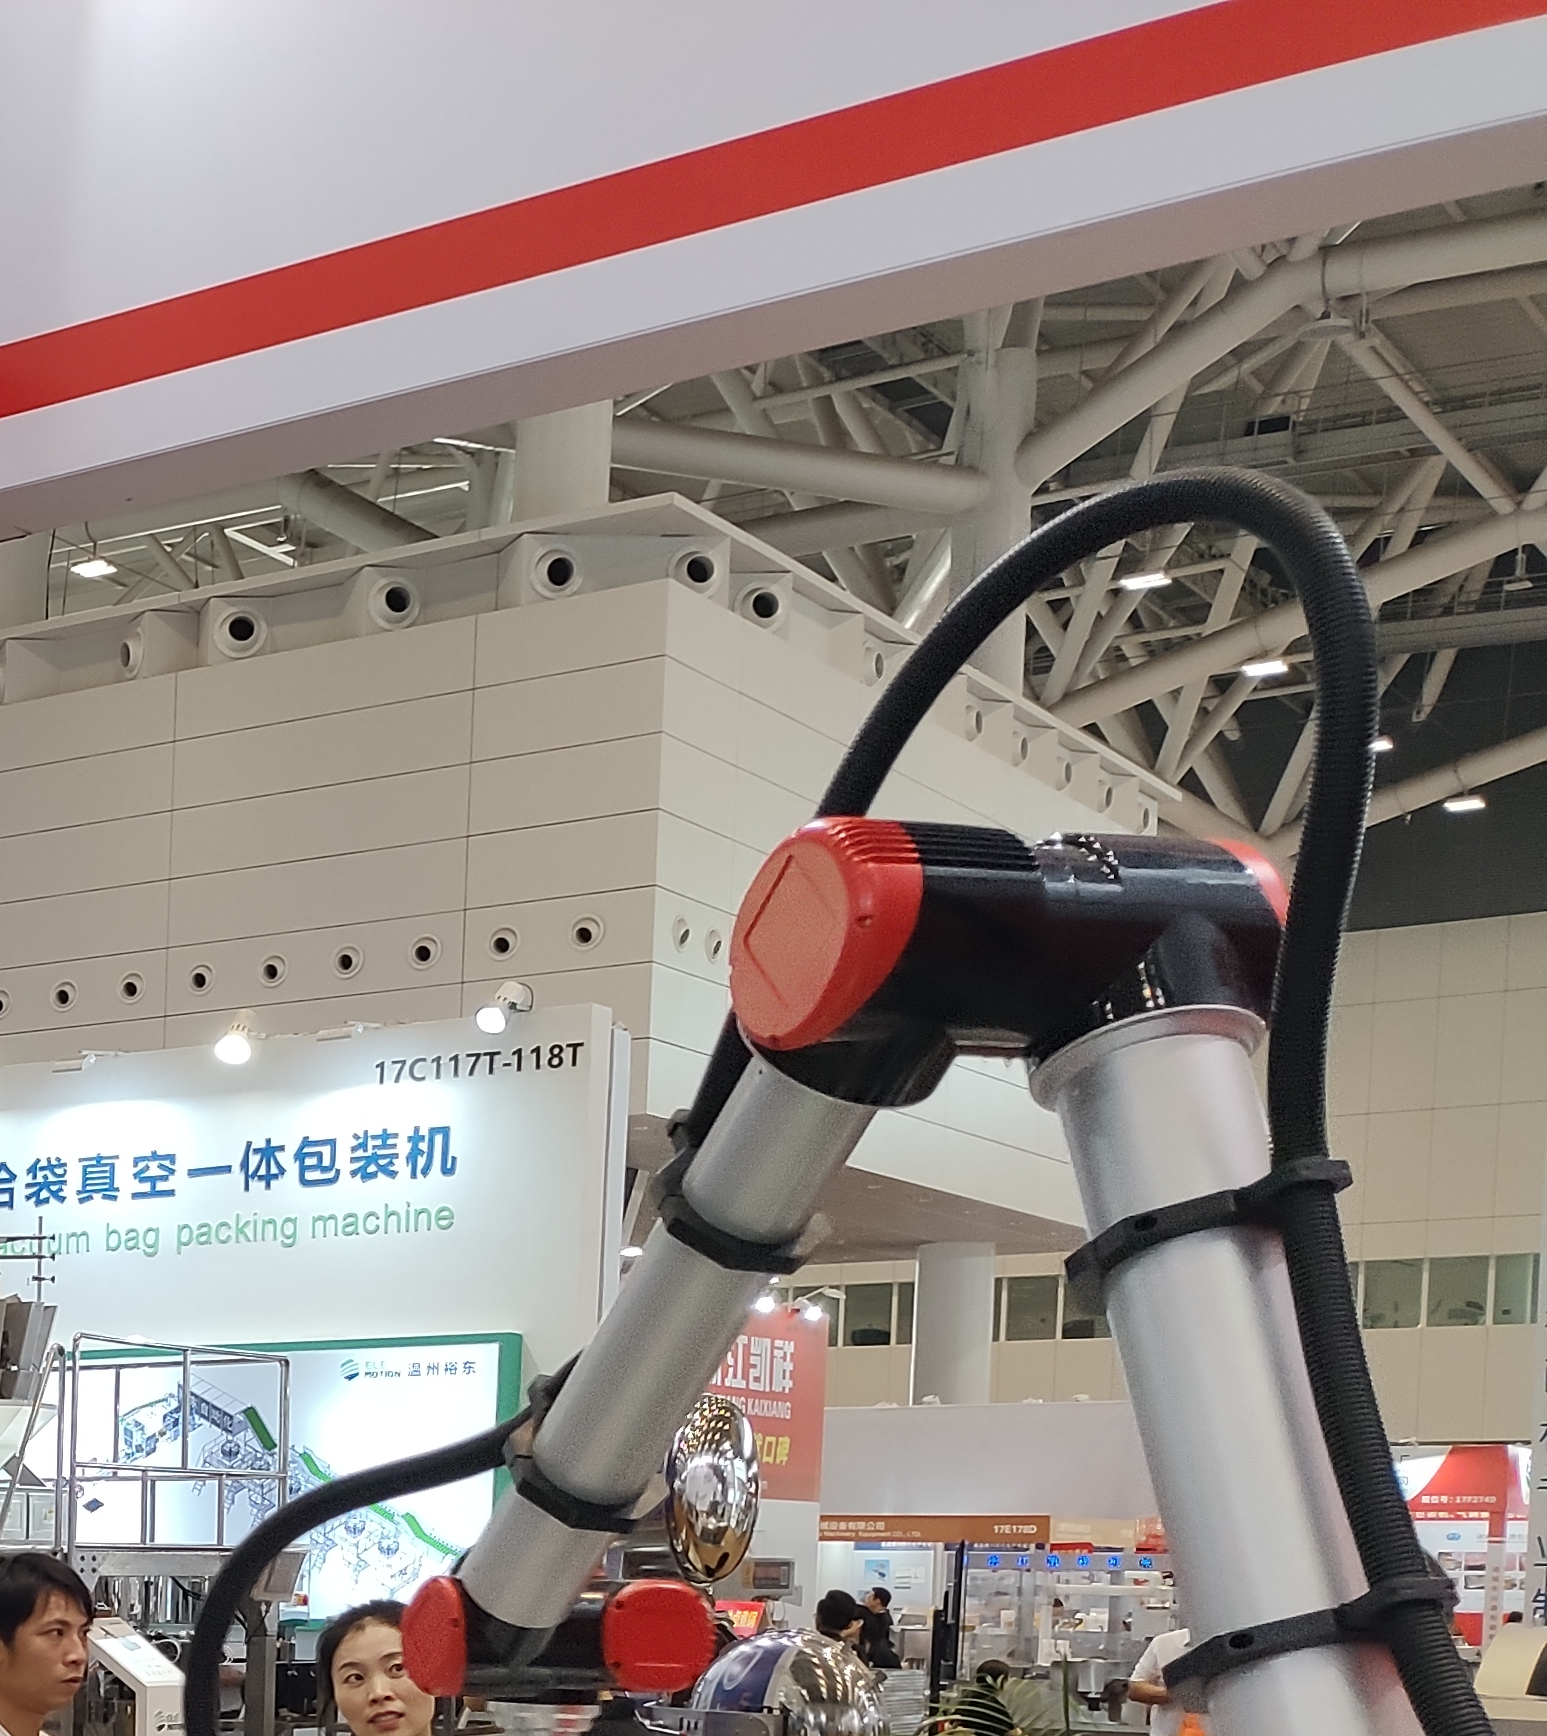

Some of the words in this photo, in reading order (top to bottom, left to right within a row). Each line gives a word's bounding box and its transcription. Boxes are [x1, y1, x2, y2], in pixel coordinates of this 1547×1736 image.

[374, 1042, 585, 1086] 17C117T-118T
[104, 1220, 160, 1258] bag
[175, 1212, 300, 1253] packing
[310, 1201, 456, 1243] machine
[407, 1360, 476, 1377] 温州裕东
